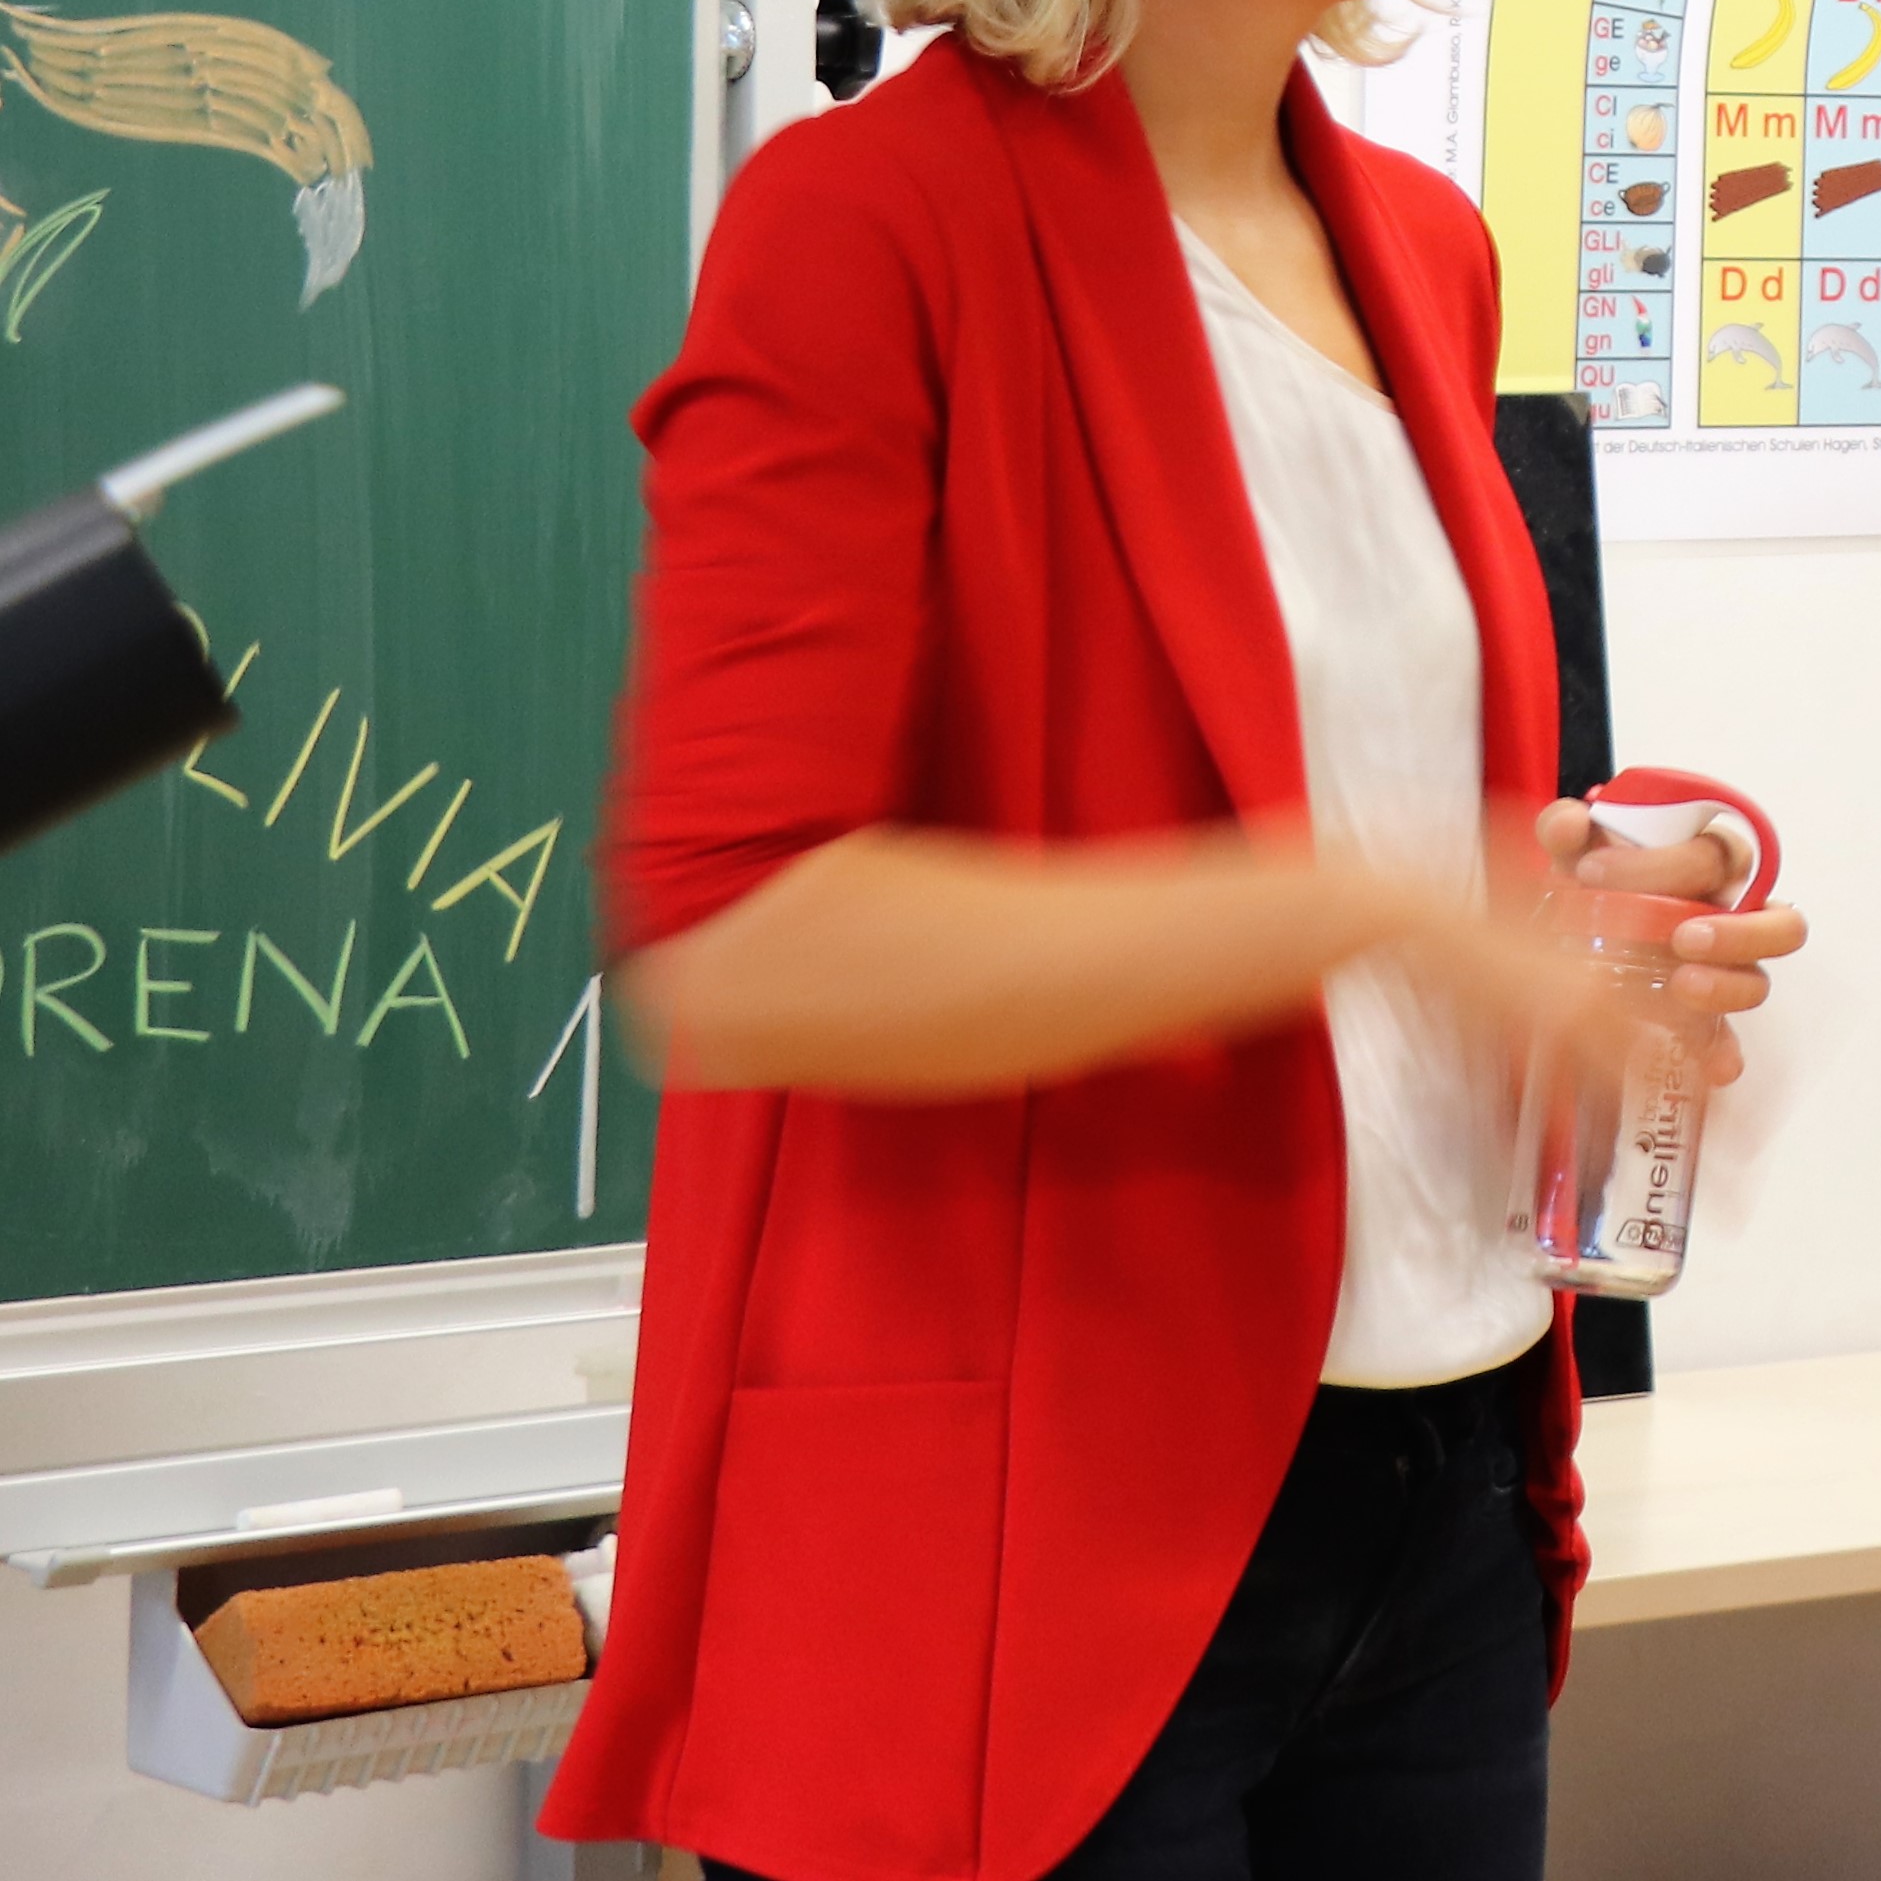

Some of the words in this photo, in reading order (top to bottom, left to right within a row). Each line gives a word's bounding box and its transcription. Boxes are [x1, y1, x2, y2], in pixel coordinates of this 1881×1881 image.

[1594, 18, 1623, 39] GE
[1595, 56, 1620, 76] ge
[1595, 95, 1617, 116] CI
[1596, 129, 1614, 149] ci
[1589, 163, 1618, 184] CE
[1591, 201, 1615, 216] ce
[1584, 230, 1620, 252] GLI
[1588, 265, 1614, 289] gli
[1583, 296, 1616, 318] GN
[1585, 334, 1611, 355] gn
[1581, 365, 1614, 387] QU
[1769, 438, 1821, 453] Schulen
[176, 602, 562, 962] LIVIA
[0, 922, 471, 1058] RENA
